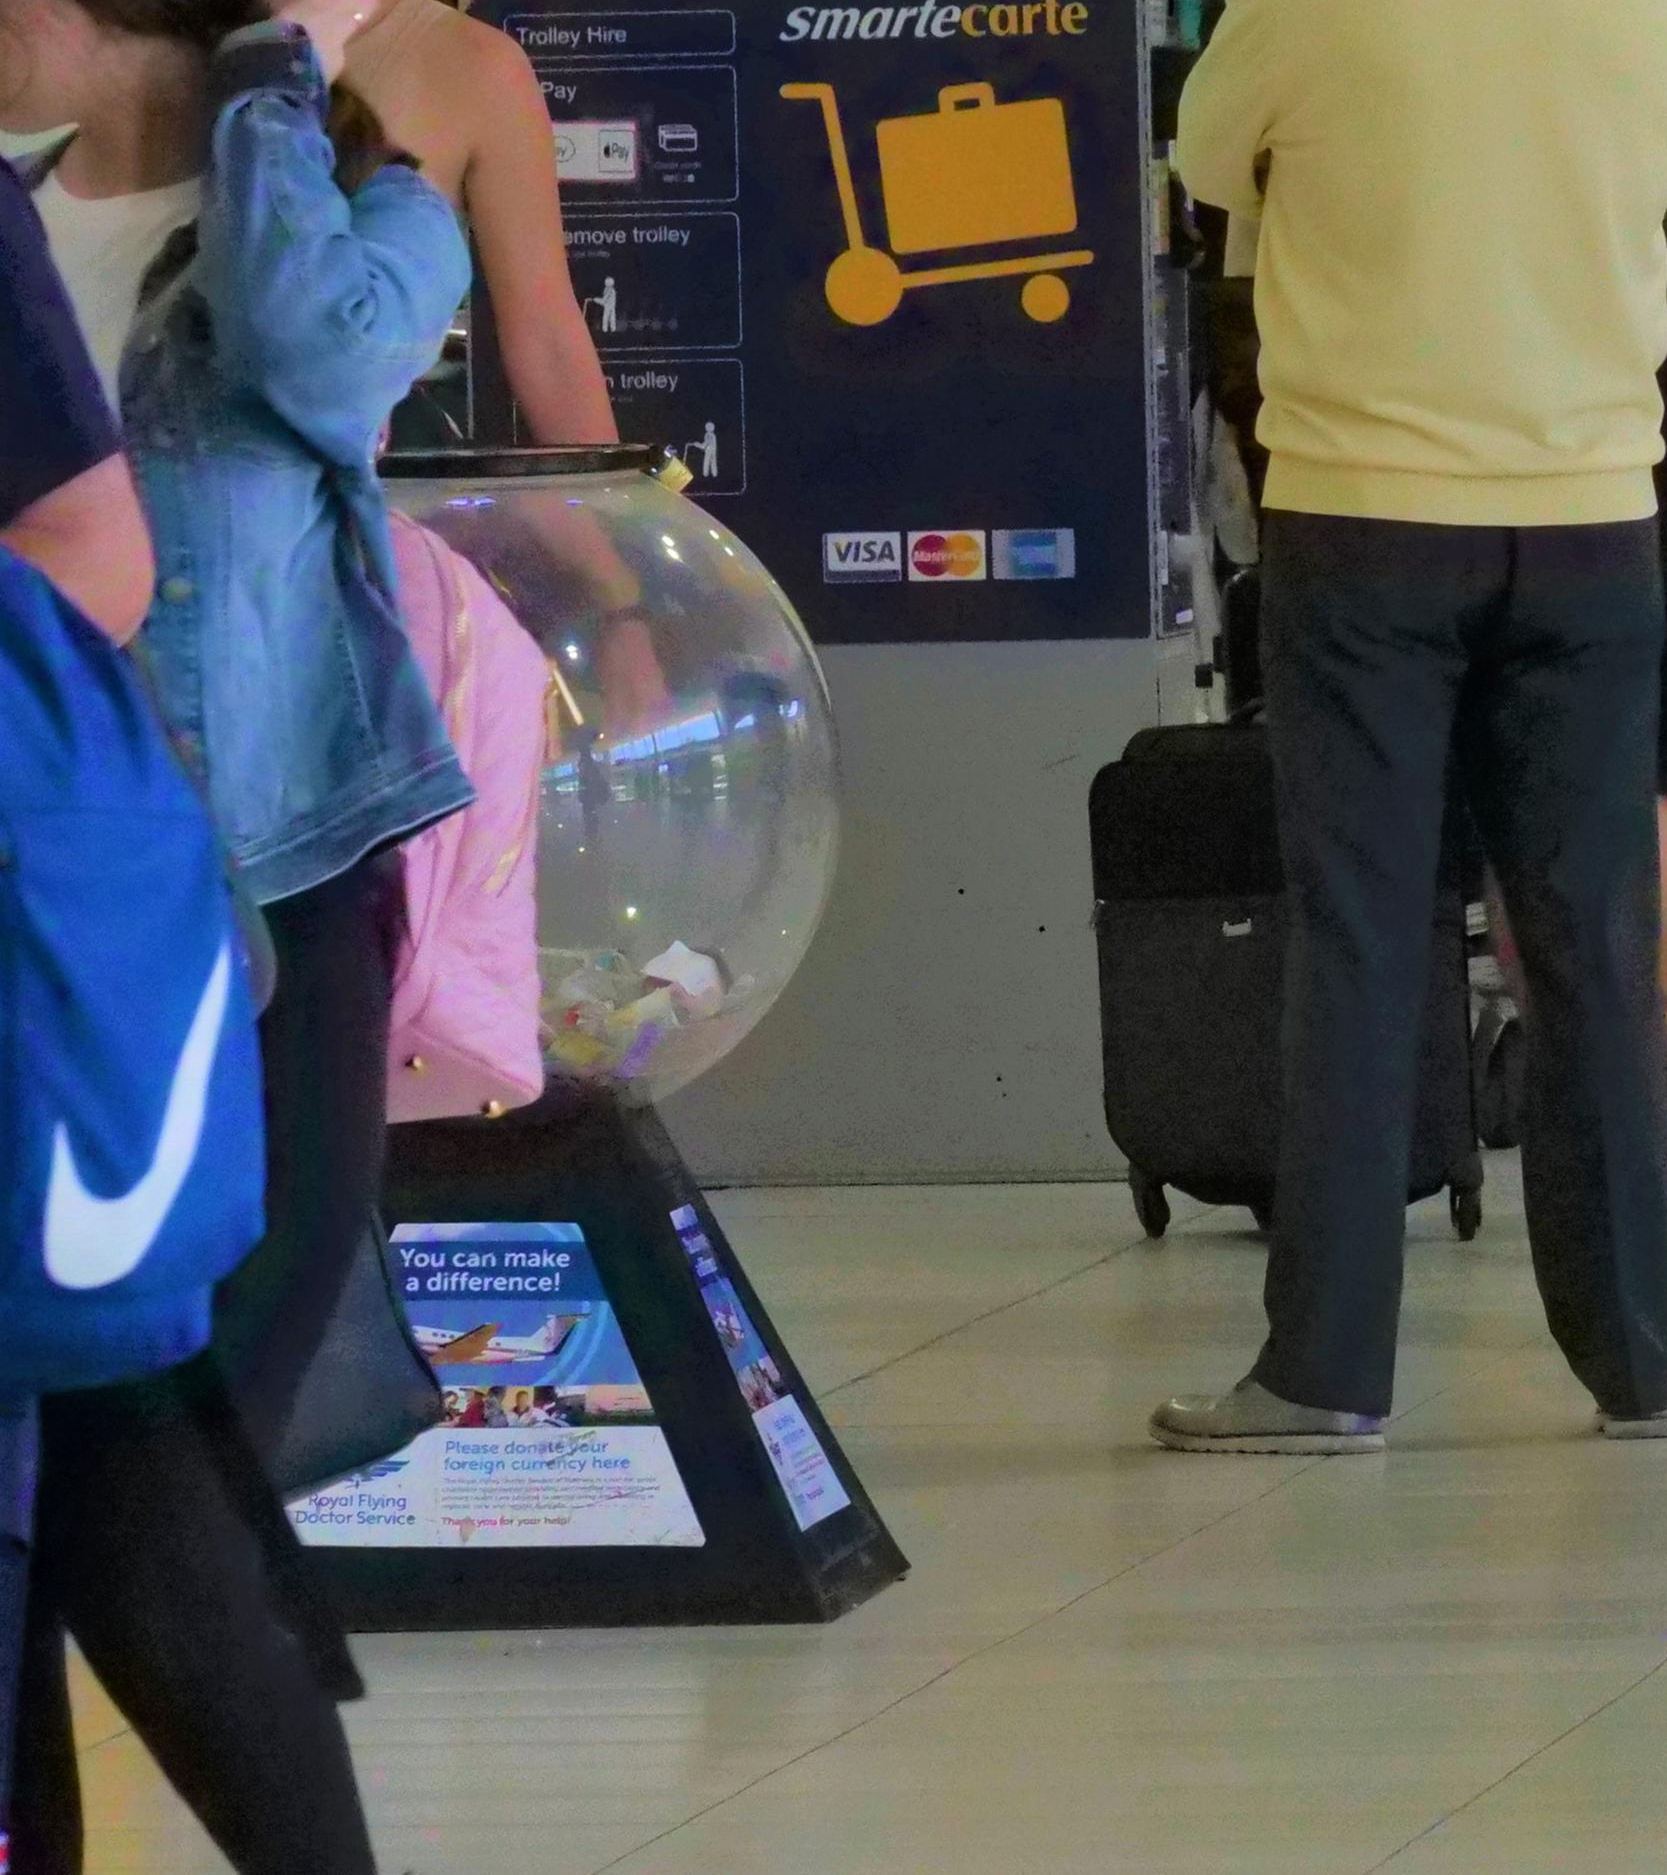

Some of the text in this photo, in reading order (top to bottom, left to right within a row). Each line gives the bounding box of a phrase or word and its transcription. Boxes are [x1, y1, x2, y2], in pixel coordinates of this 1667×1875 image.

[516, 25, 628, 49] Trolley Hire
[540, 81, 578, 103] Pay
[565, 225, 691, 247] emove trolley
[620, 371, 679, 393] trolley
[834, 539, 896, 563] VISA
[399, 1248, 571, 1268] You can make
[405, 1271, 561, 1293] a difference!
[445, 1440, 609, 1458] Please donate your
[444, 1455, 631, 1475] foreign currency here
[308, 1493, 407, 1511] Royal Flying
[295, 1510, 416, 1526] Doctor Service
